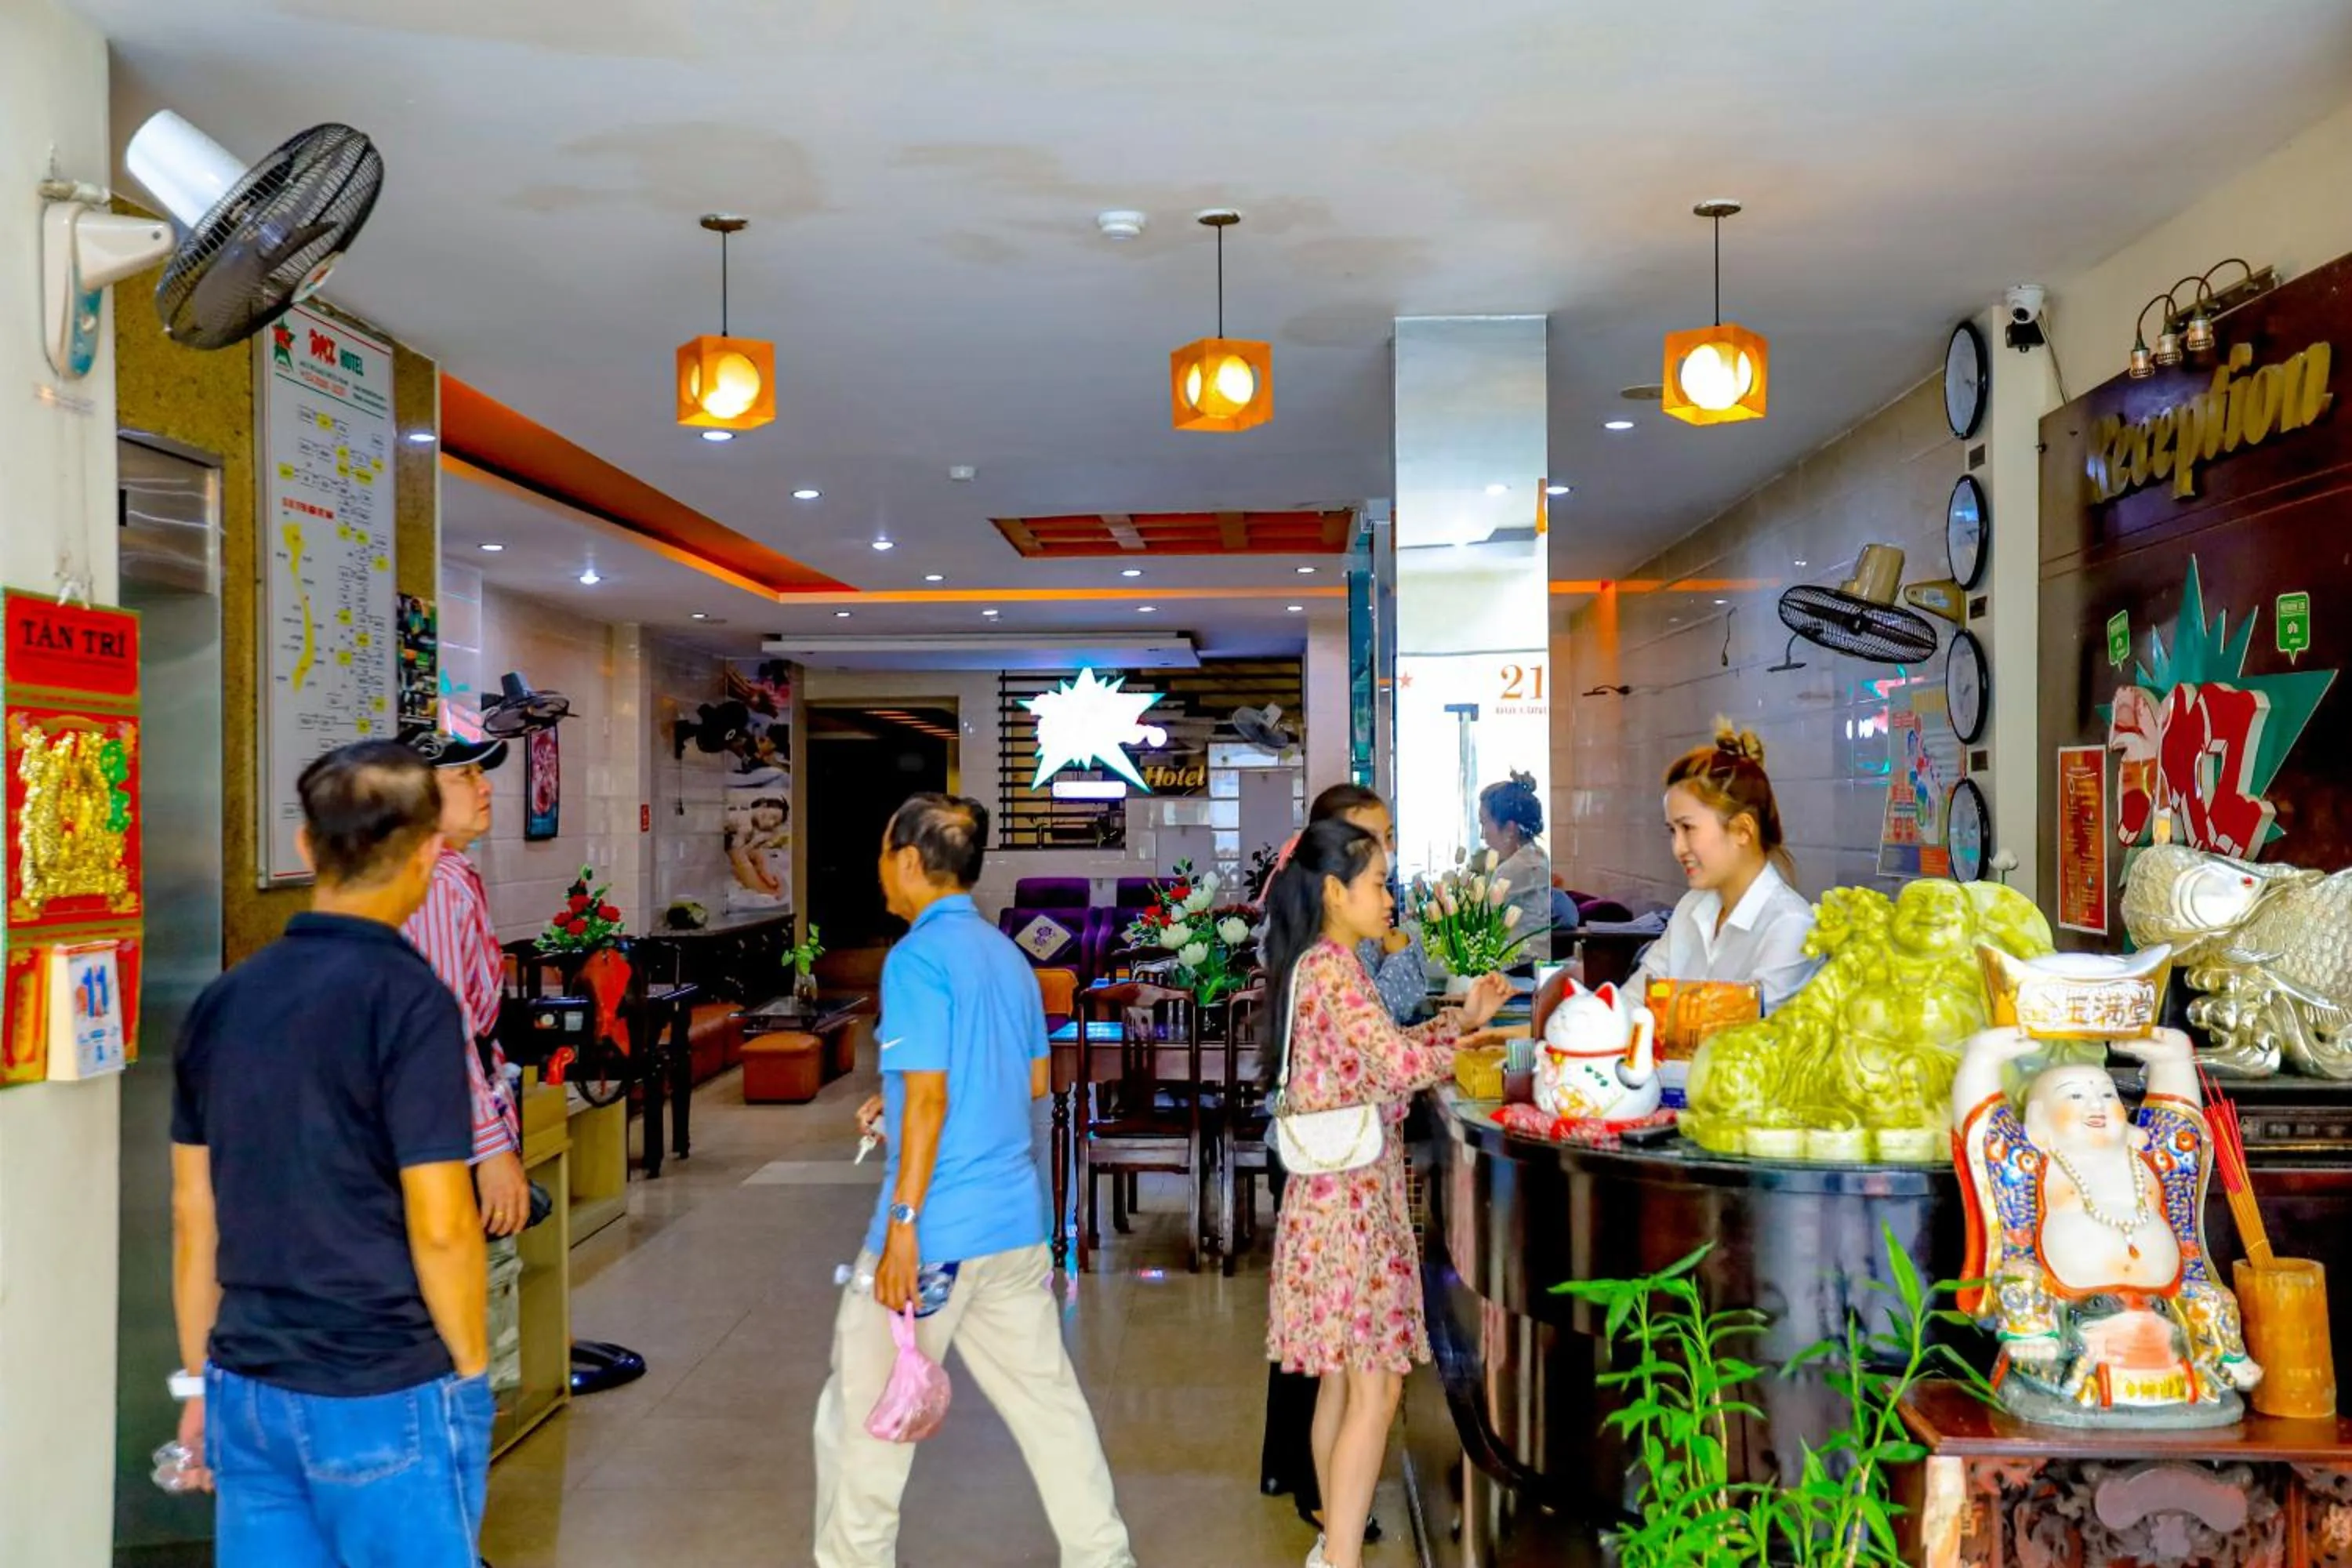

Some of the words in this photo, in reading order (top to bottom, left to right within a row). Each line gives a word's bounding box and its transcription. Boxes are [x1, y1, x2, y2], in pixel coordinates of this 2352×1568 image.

[339, 349, 364, 376] HOTEL
[2086, 342, 2333, 504] Reception
[1500, 664, 1543, 700] 21
[1144, 765, 1206, 787] Hotel
[82, 965, 108, 1017] 11
